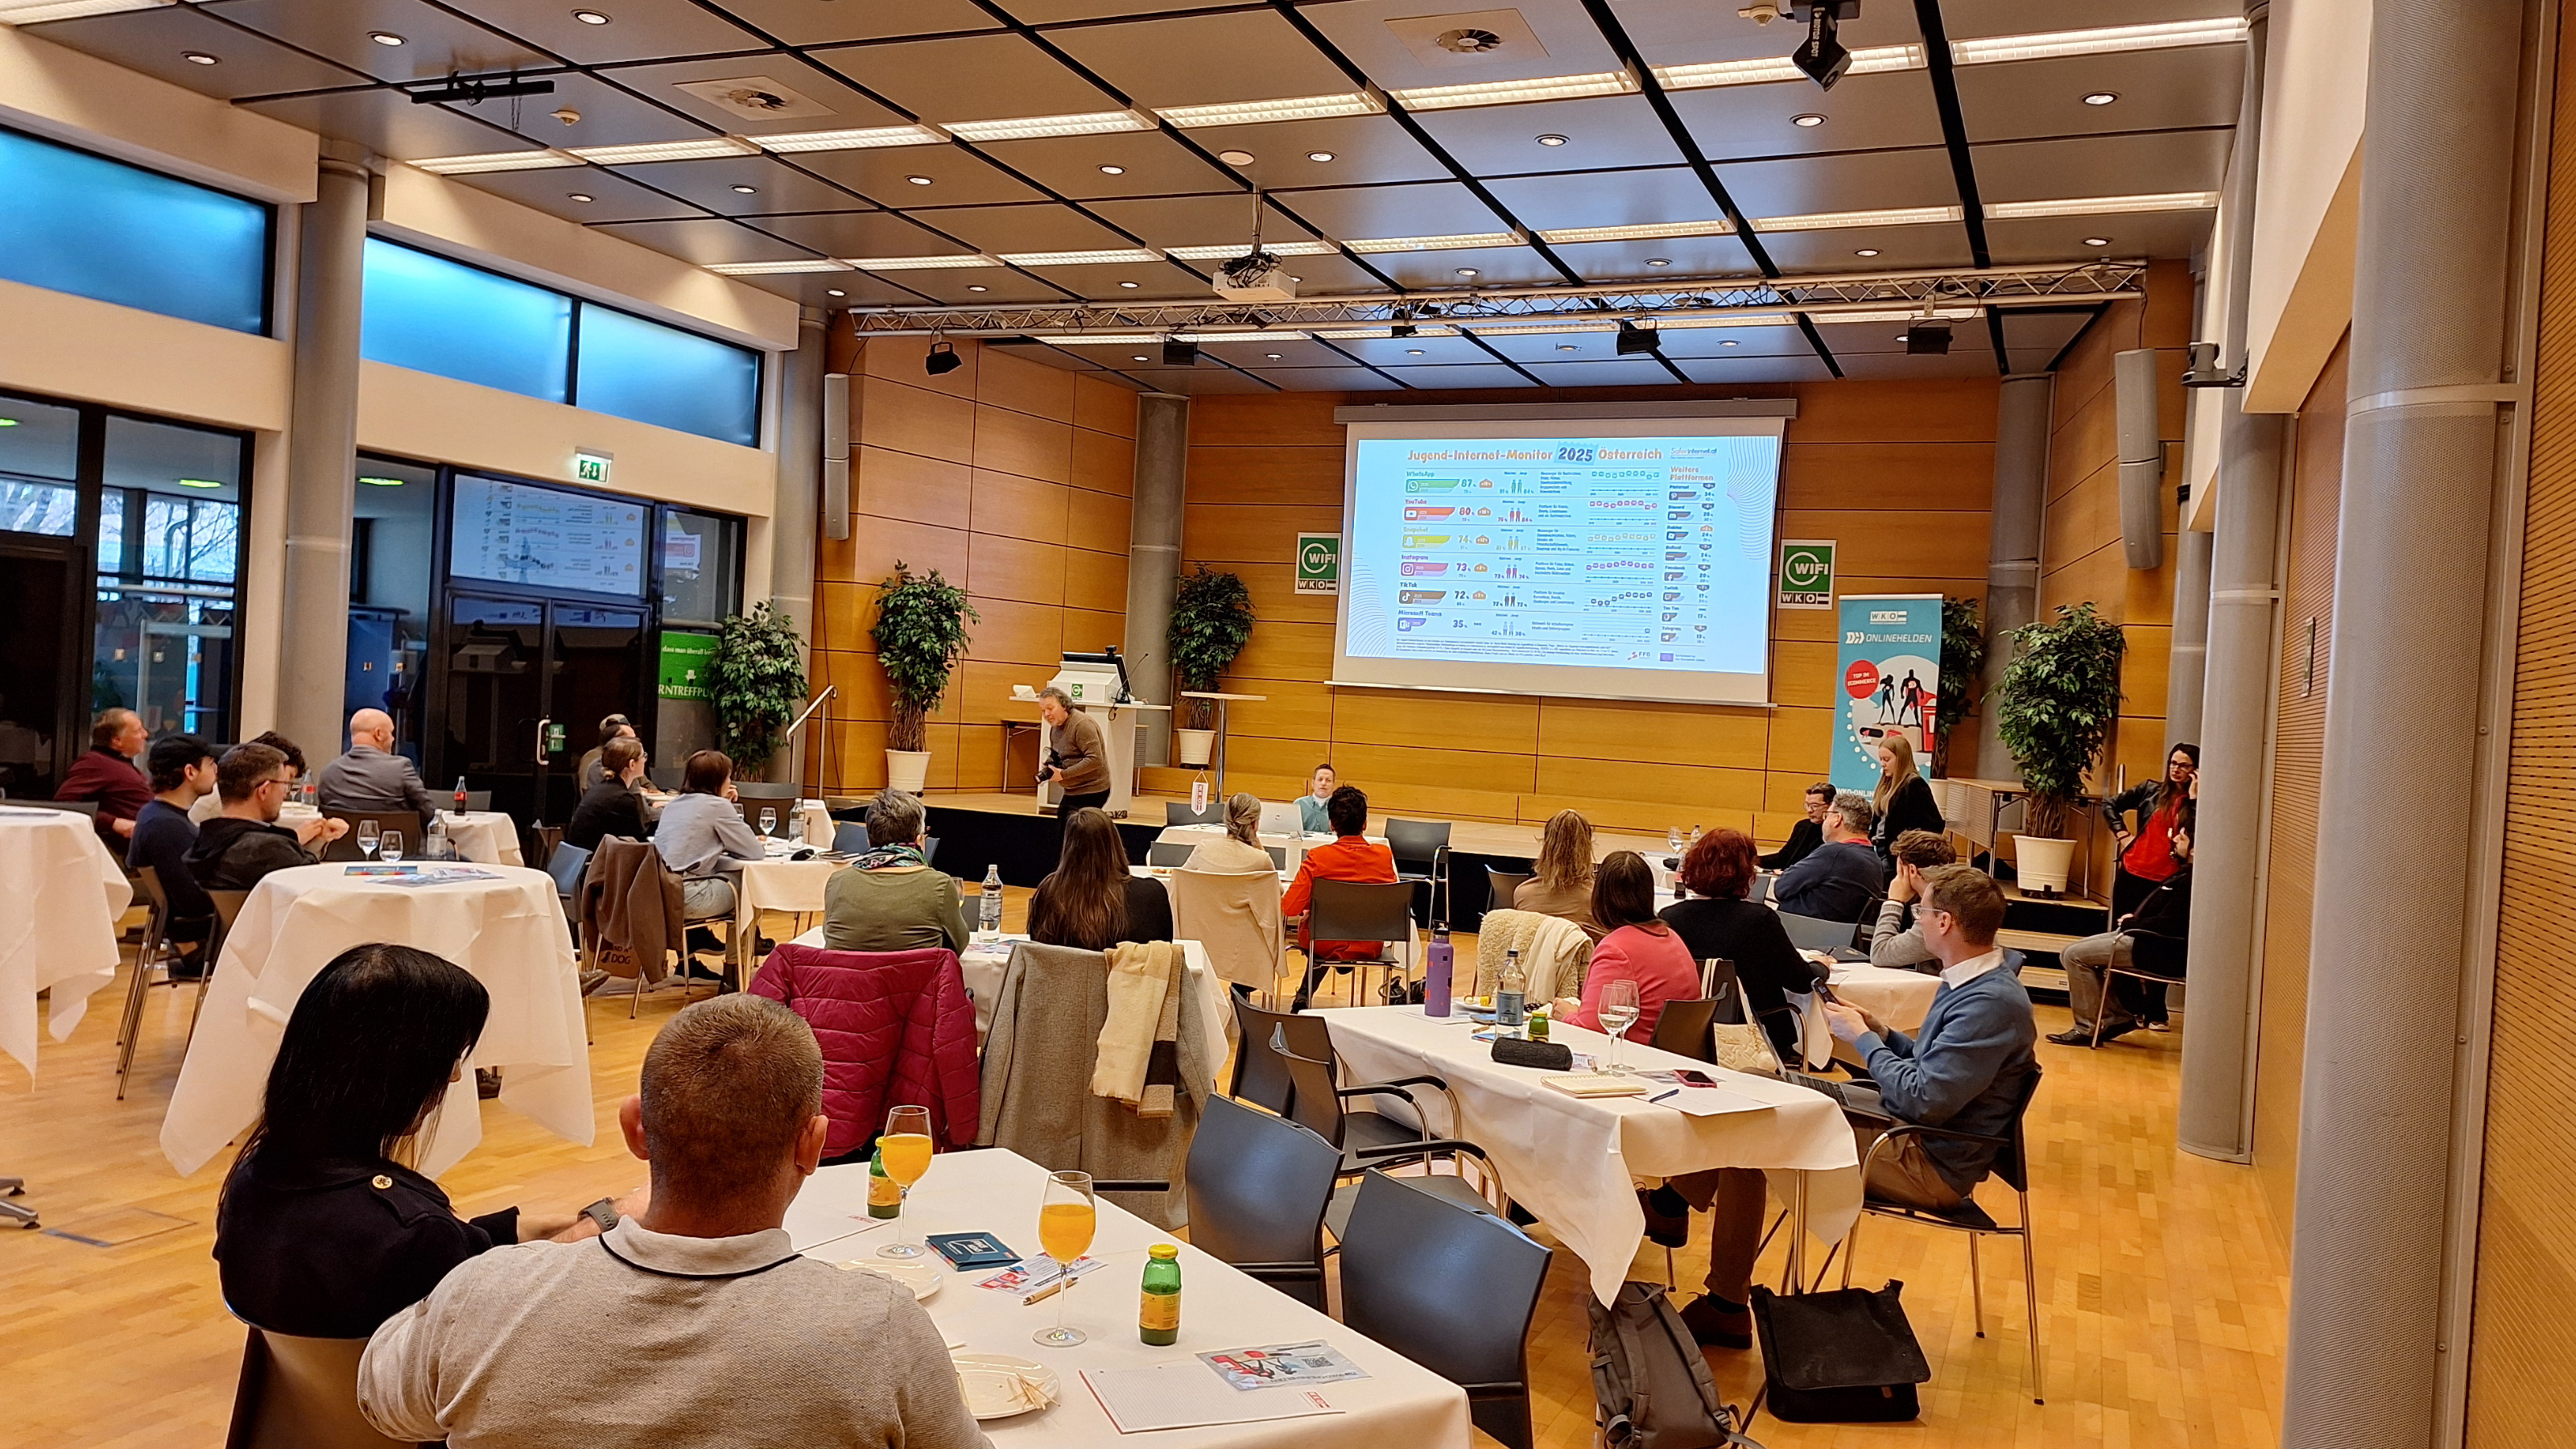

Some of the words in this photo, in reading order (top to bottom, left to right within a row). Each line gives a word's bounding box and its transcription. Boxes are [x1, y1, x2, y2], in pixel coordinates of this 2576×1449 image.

[1407, 449, 1553, 463] Jugend-Internet-Monitor
[1558, 447, 1593, 462] 2025
[1599, 446, 1662, 460] Österreich
[1309, 553, 1336, 564] WIFI
[1456, 563, 1467, 571] 73
[1795, 563, 1828, 575] WIFI
[1298, 580, 1325, 589] WKO
[1454, 591, 1465, 599] 72
[1781, 594, 1815, 603] WKO
[1453, 619, 1464, 628] 35
[1866, 634, 1932, 643] ONLINEHELDEN
[1847, 678, 1876, 686] ECOMMERCE
[611, 954, 631, 965] DOG
